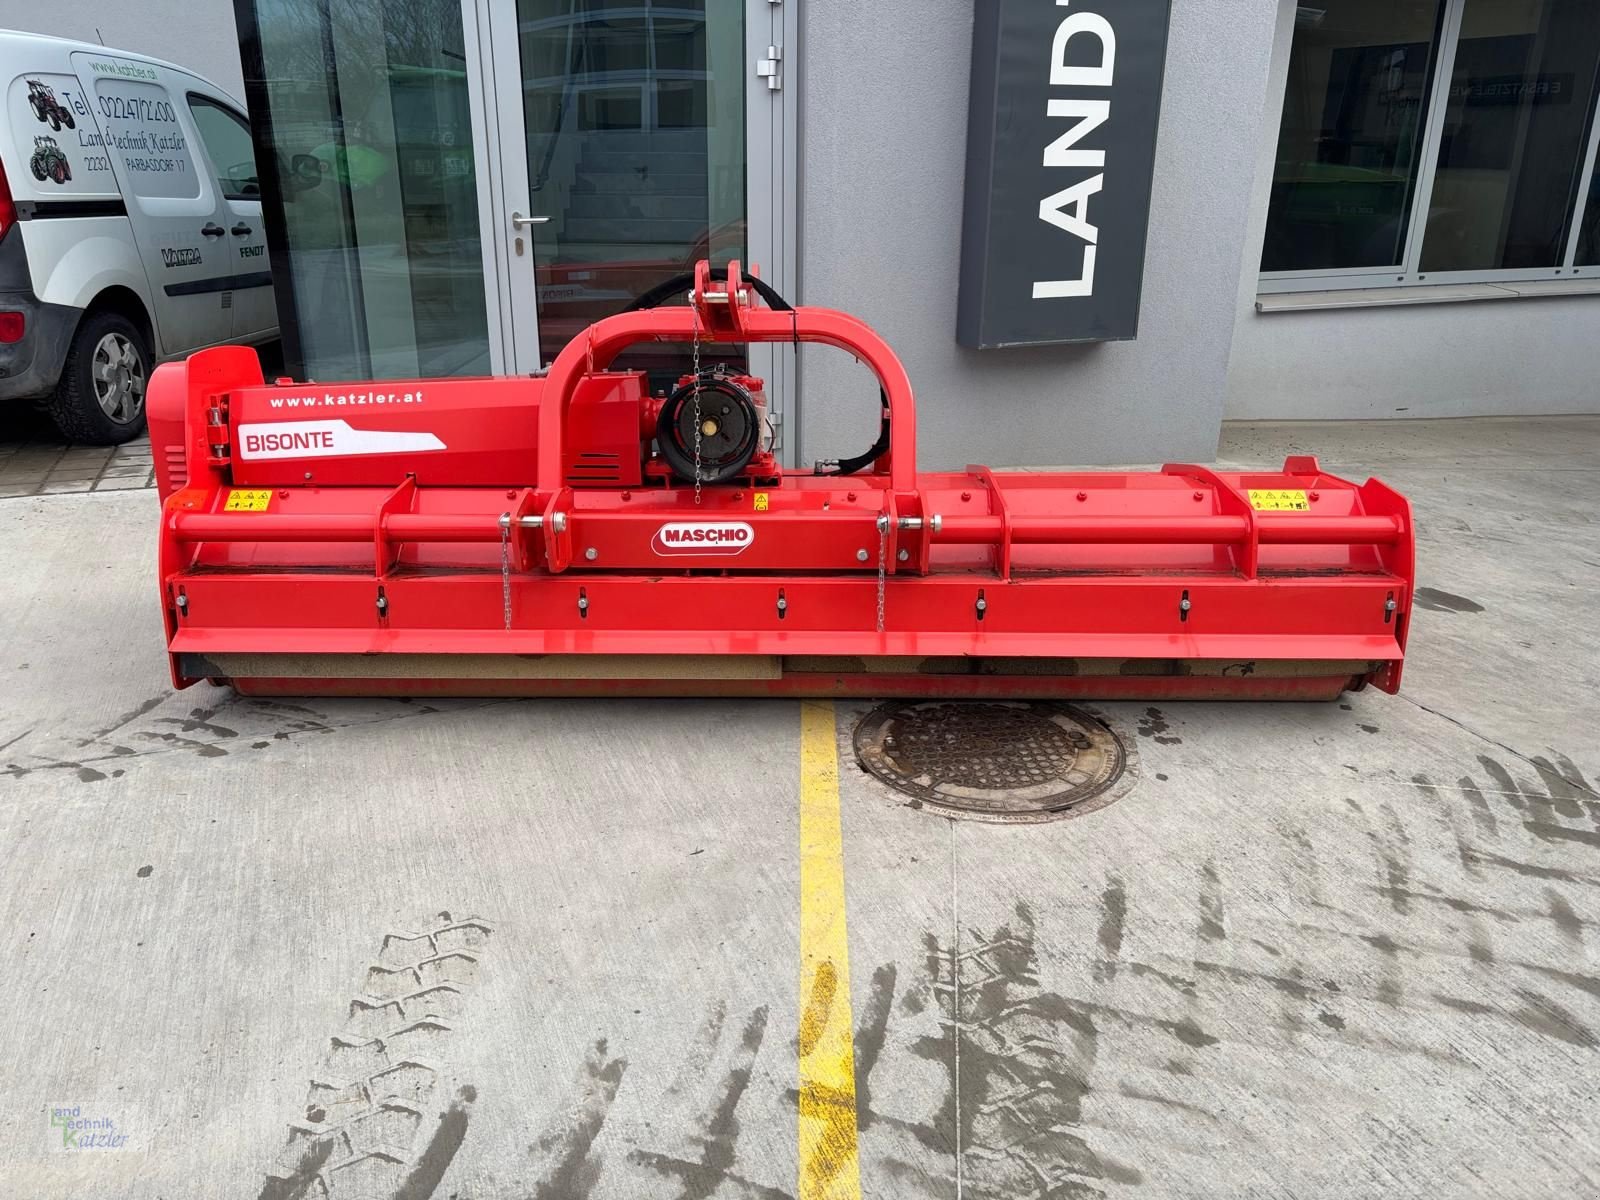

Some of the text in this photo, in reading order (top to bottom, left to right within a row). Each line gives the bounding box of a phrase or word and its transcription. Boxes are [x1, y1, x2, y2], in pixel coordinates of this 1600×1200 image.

[88, 60, 158, 80] www.katzler.at
[149, 131, 185, 154] Katzler
[1032, 0, 1116, 299] LAND
[84, 157, 185, 173] 2232 PARBASDORF 17
[239, 245, 265, 258] FENDT
[270, 391, 423, 408] www.katzler.at
[246, 431, 333, 452] BISONTE
[665, 528, 748, 542] MASCHIO
